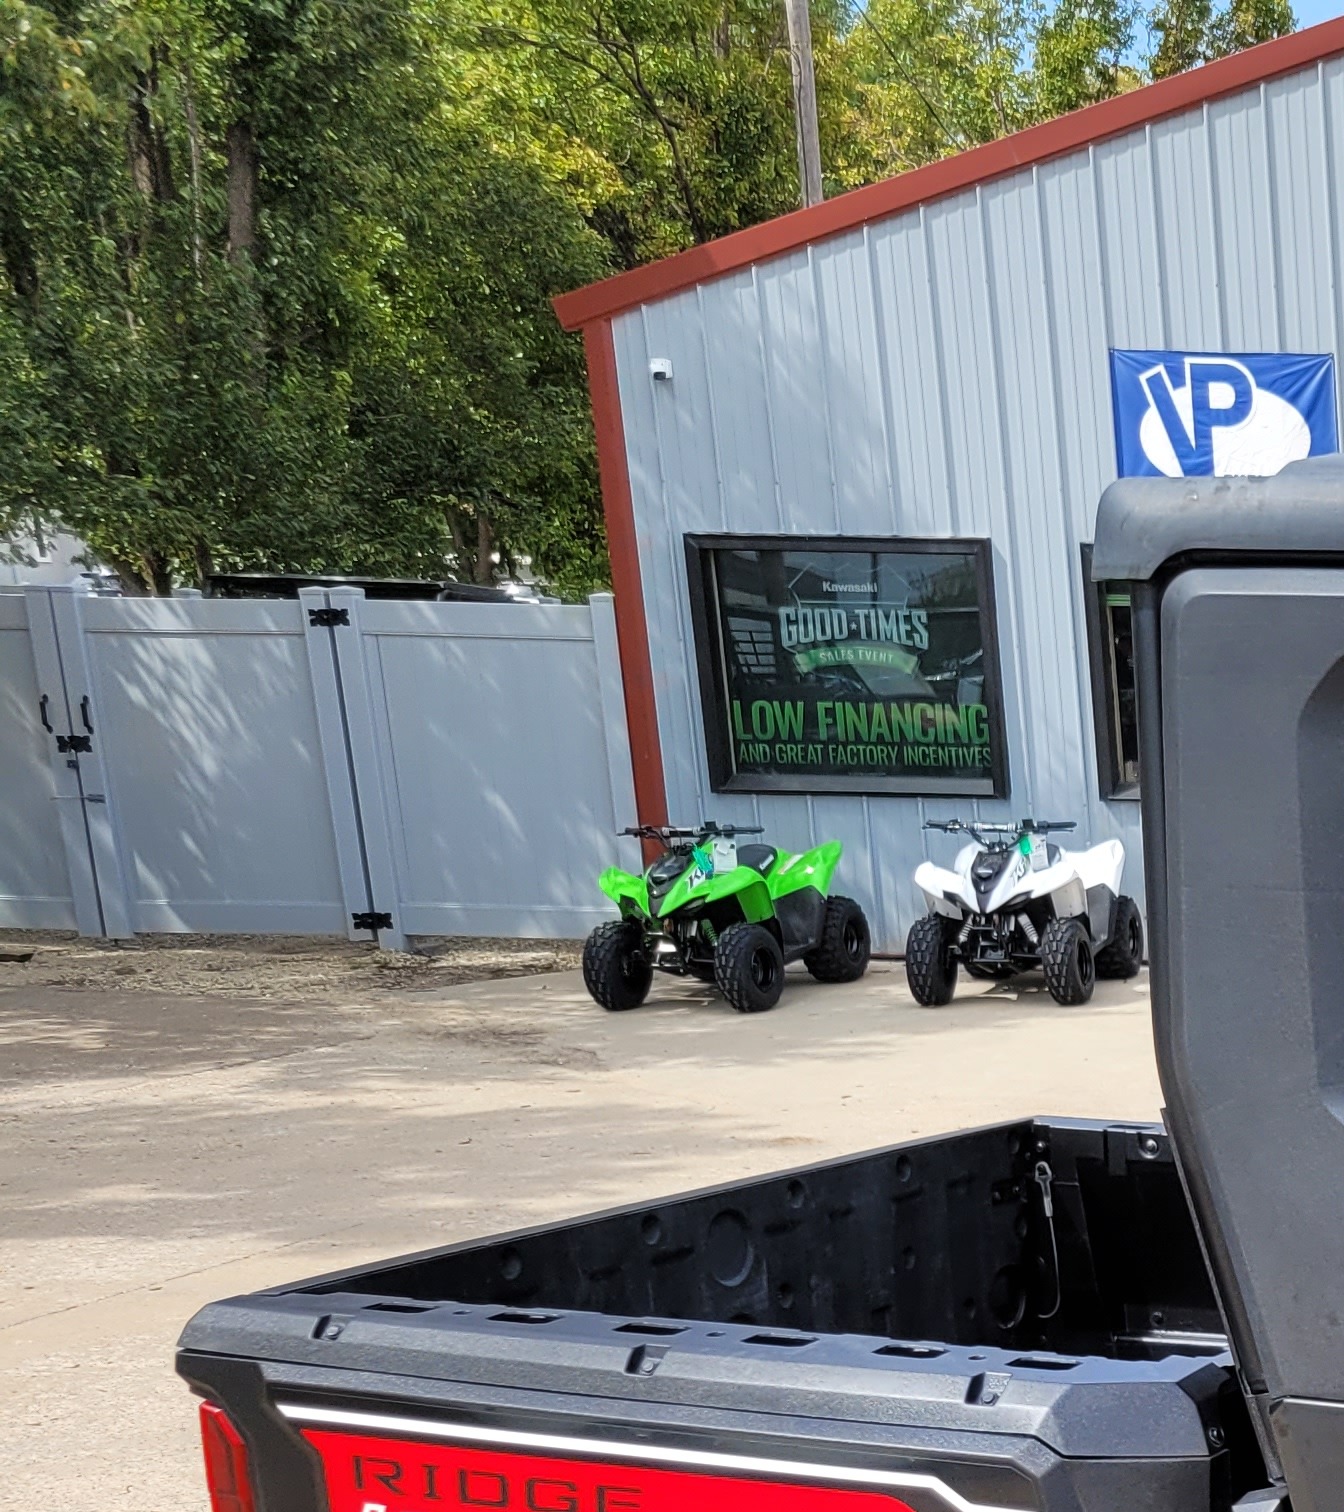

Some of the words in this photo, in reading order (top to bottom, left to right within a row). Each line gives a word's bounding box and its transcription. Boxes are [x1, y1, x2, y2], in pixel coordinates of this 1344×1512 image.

[1139, 357, 1256, 477] VP
[822, 581, 878, 593] Kawasaki
[778, 605, 848, 647] GOOD
[854, 607, 929, 650] TIMES
[819, 650, 854, 663] SALES
[858, 651, 894, 663] EVENT
[732, 700, 805, 741] LOW
[816, 701, 991, 744] FINANCING
[739, 742, 770, 764] AND
[775, 743, 824, 766] GREAT
[828, 744, 899, 766] FACTORY
[903, 745, 992, 768] INCENTIVES
